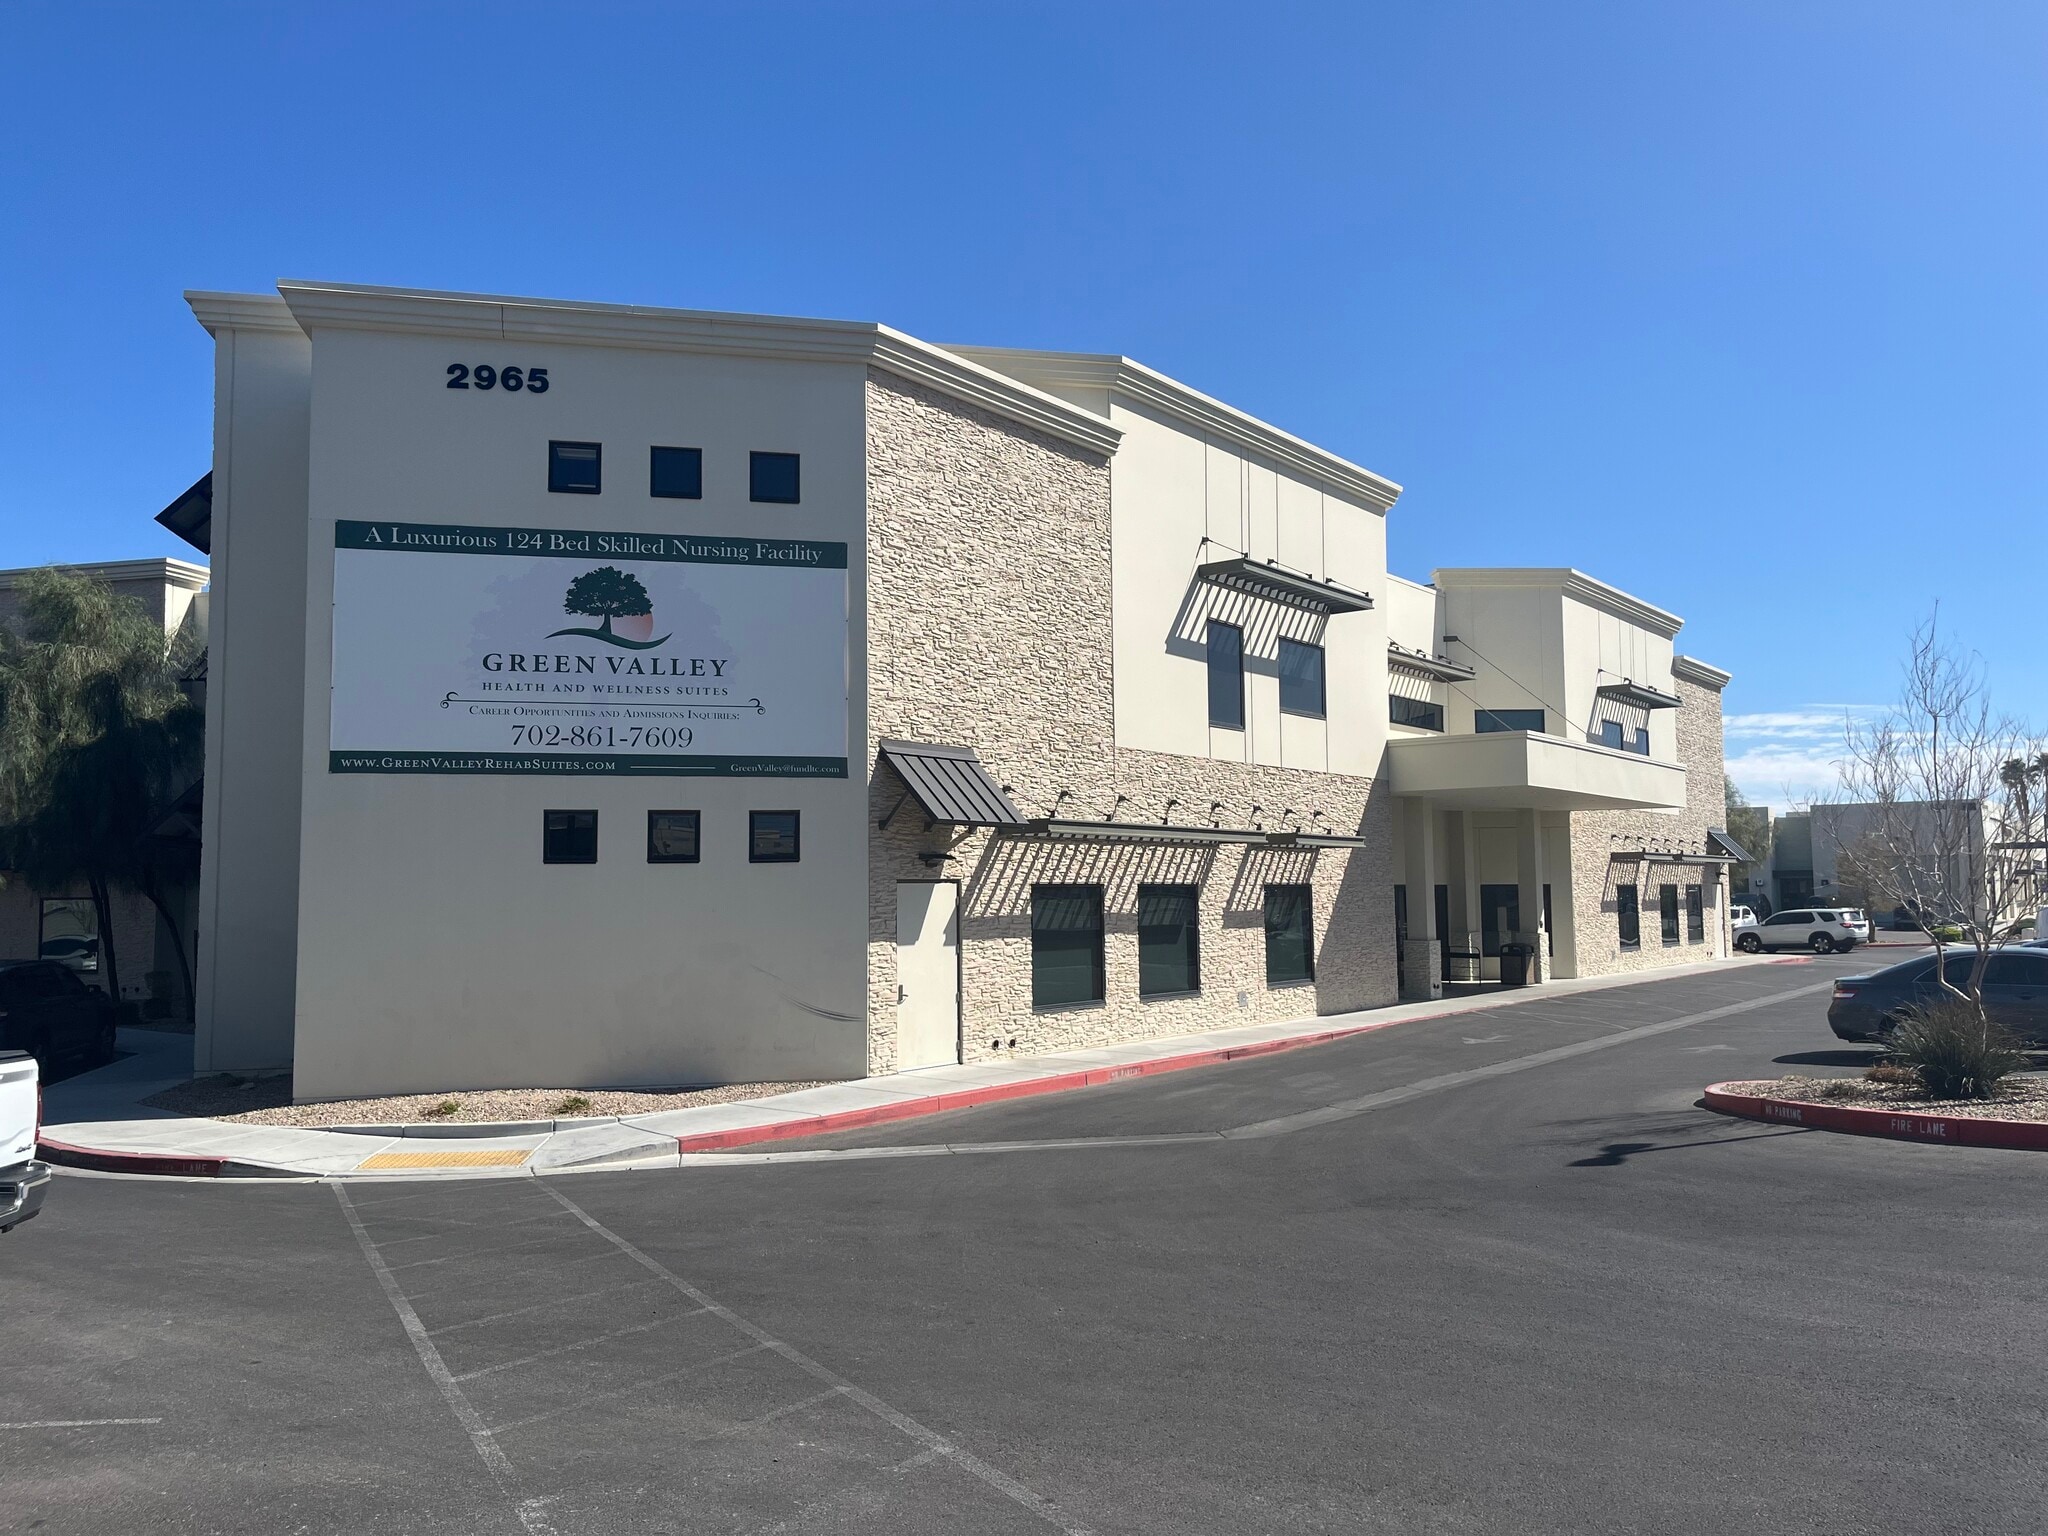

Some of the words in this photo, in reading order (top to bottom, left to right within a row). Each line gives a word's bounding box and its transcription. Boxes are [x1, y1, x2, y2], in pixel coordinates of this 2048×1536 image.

[447, 363, 549, 394] 2965
[365, 526, 383, 543] A
[391, 527, 497, 548] Luxurious
[506, 532, 543, 549] 124
[550, 534, 589, 551] Bed
[597, 536, 664, 555] Skilled
[672, 539, 749, 561] Nursing
[756, 543, 823, 564] Facility
[482, 653, 597, 674] GREEN
[605, 656, 729, 677] VALLEY
[482, 682, 545, 692] HEALTH
[552, 684, 585, 693] AND
[592, 685, 670, 695] WELLNESS
[676, 686, 729, 696] SUITES
[511, 724, 694, 748] 702-861-7609
[1891, 1118, 1913, 1132] FIRE
[1919, 1120, 1946, 1137] LANE
